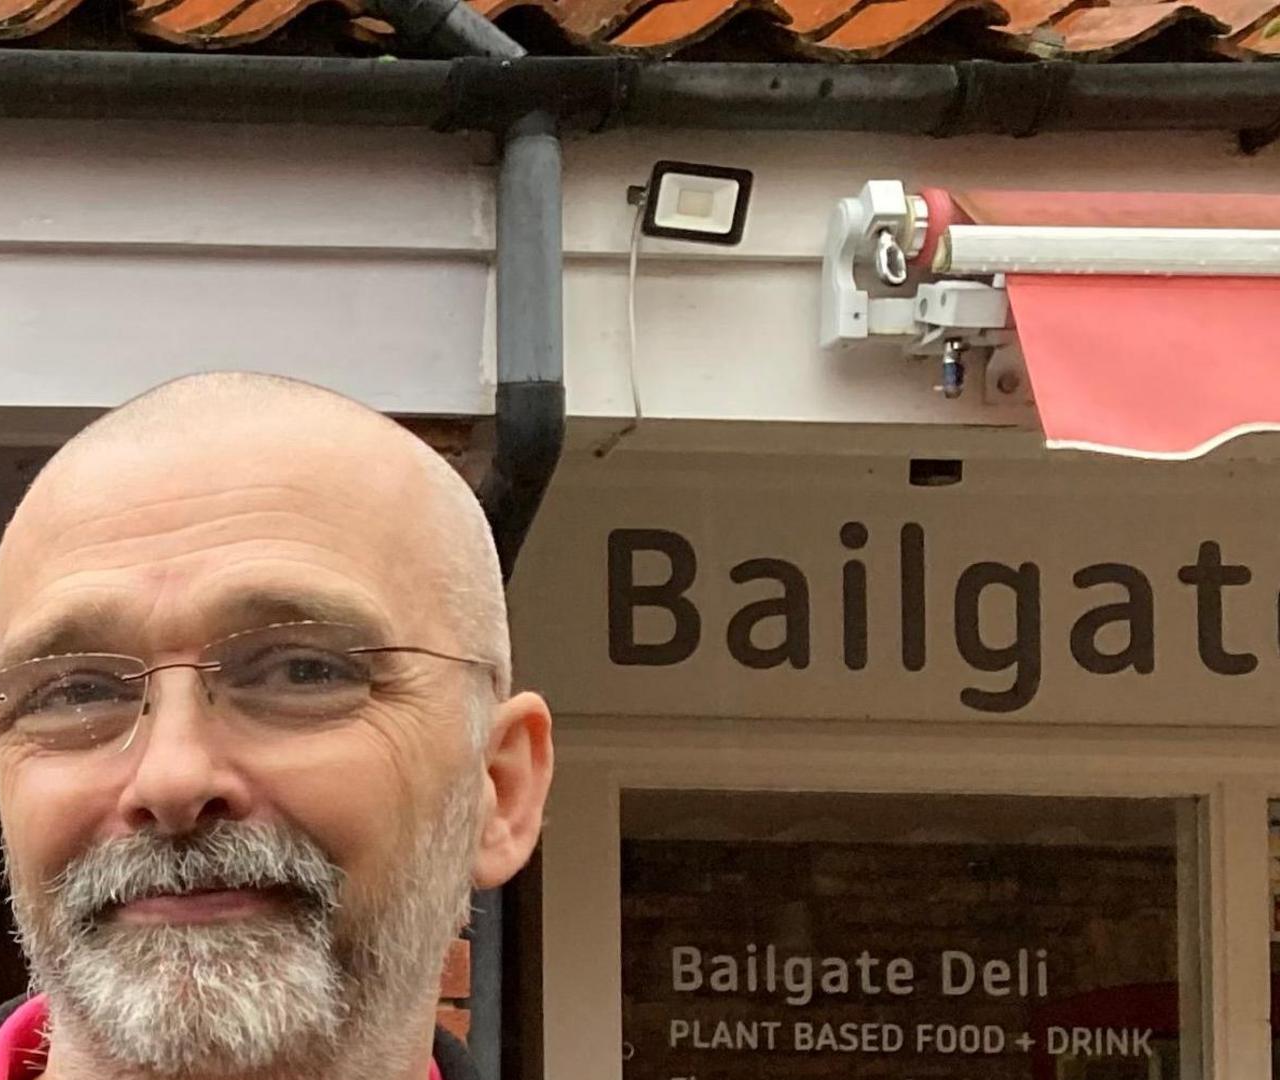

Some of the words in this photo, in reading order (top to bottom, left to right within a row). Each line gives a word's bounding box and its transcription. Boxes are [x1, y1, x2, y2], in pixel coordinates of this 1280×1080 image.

[606, 520, 1280, 713] Bailgat
[672, 943, 914, 1006] Bailgate
[941, 948, 1048, 997] Deli
[670, 1019, 782, 1050] PLANT
[794, 1021, 904, 1052] BASED
[916, 1024, 1005, 1054] FOOD
[1015, 1031, 1036, 1052] +
[1047, 1025, 1153, 1057] DRINK
